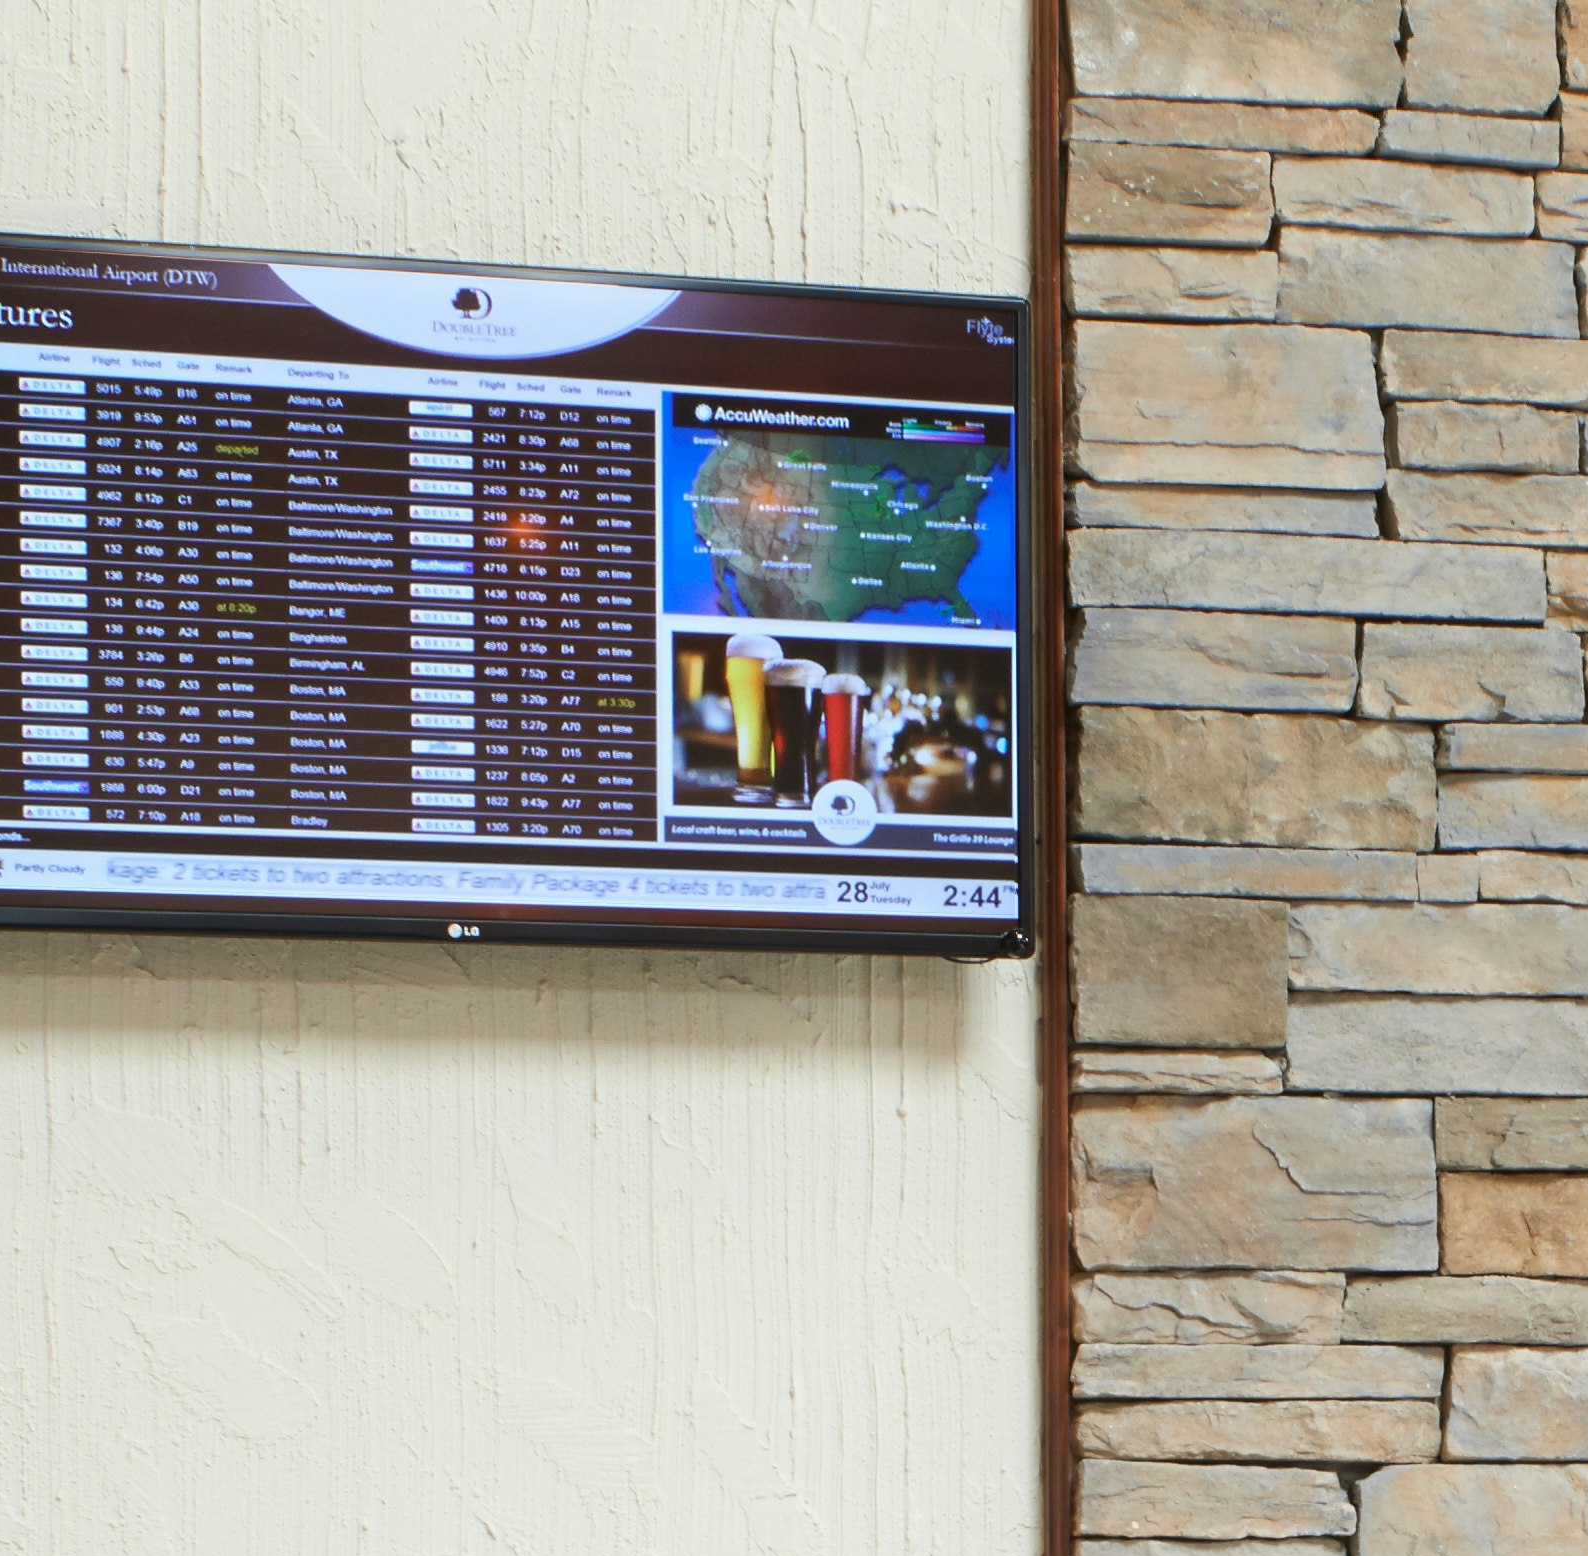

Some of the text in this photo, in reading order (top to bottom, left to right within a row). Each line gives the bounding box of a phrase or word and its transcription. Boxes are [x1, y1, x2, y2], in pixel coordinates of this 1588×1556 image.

[2, 257, 98, 280] International
[102, 264, 158, 285] Airport
[163, 268, 217, 289] (DTW)
[39, 352, 70, 363] Airline
[92, 355, 120, 368] Flight
[132, 358, 161, 369] Sched
[177, 361, 199, 371] Gate
[215, 362, 252, 374] Remark
[288, 368, 632, 398] Departing To Airline Flight Sched Gate Remark
[215, 391, 252, 402] on time
[714, 406, 850, 429] AccuWeather.com
[15, 864, 85, 876] Partly Cloudy
[173, 863, 329, 885] 2 tickets to two
[532, 874, 619, 897] Package
[626, 878, 639, 893] 4
[646, 877, 709, 896] tickets
[716, 880, 734, 897] to
[740, 881, 776, 898] two
[837, 881, 868, 903] 28
[870, 881, 891, 891] July
[944, 885, 1001, 908] 2:44
[871, 895, 912, 906] Tuesday
[464, 926, 480, 937] LG
